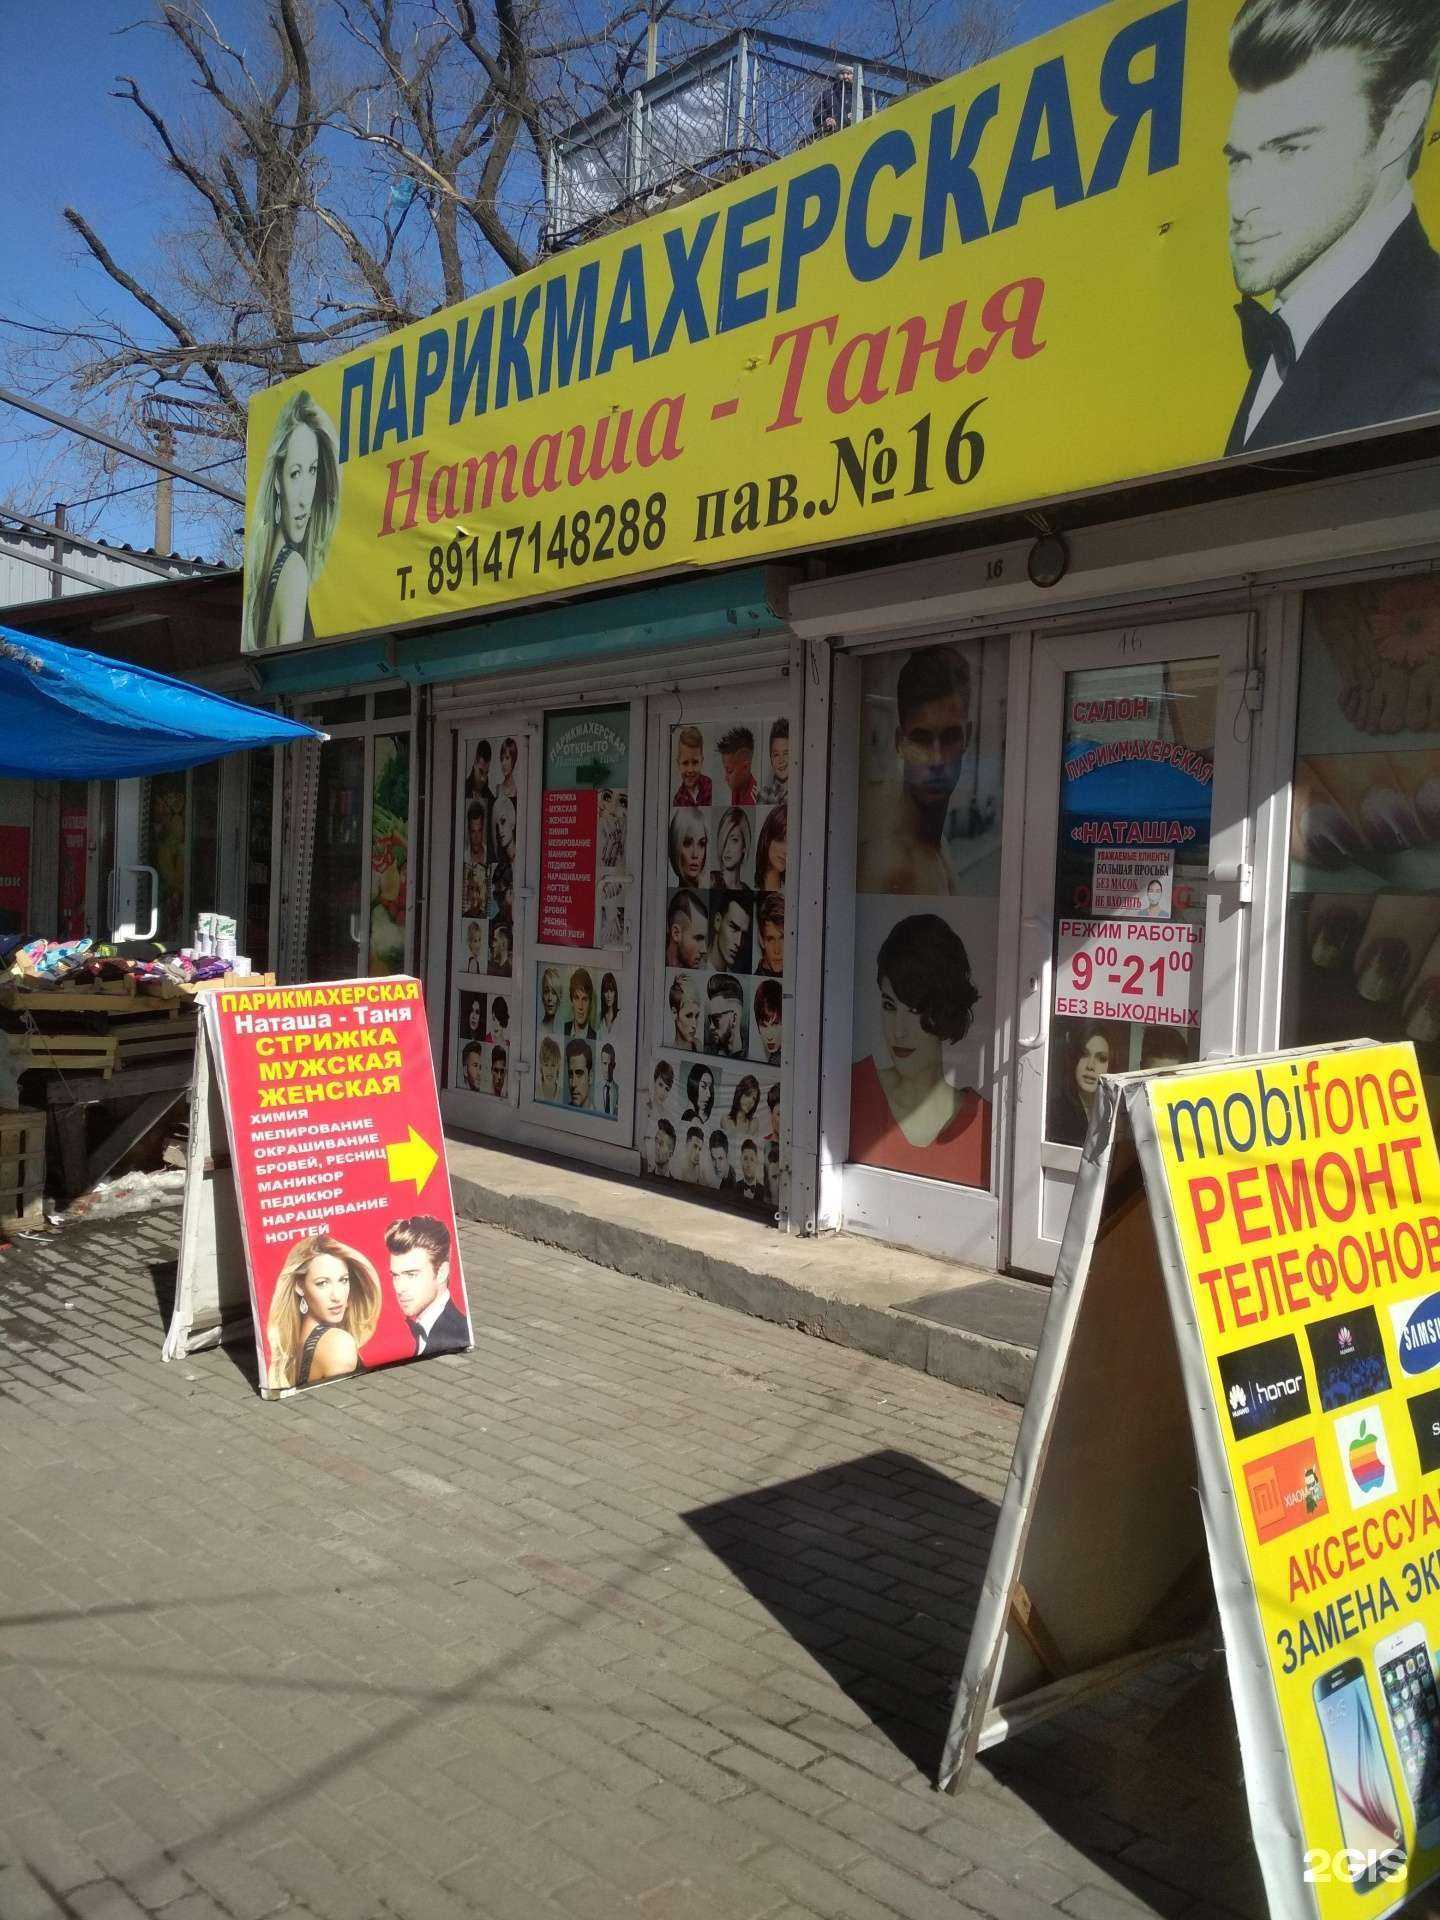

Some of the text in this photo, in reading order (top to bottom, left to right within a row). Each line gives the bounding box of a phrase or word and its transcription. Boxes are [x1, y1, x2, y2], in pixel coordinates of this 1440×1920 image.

[338, 0, 1189, 465] ПАРИКМАХЕРСКАЯ
[377, 393, 686, 538] Наташа
[765, 277, 1047, 433] Таня
[427, 492, 667, 596] 89147148288
[986, 558, 1004, 581] 16
[1072, 697, 1149, 722] САЛОН
[1065, 739, 1214, 785] ПАРИКМАХЕРСКАЯ
[1096, 863, 1169, 876] БОЛЬШАЯ ПРОСЬБА
[1096, 878, 1139, 890] БЕЗ МАСОК
[1095, 896, 1105, 908] НЕ
[1061, 922, 1203, 944] РЕЖИМ РАБОТЫ
[221, 983, 419, 1013] ПАРИКМАХЕРСКАЯ
[1057, 997, 1199, 1026] БЕЗ ВЫХОДНЫХ
[234, 1011, 332, 1035] Наташа
[353, 1004, 412, 1026] Таня
[255, 1027, 397, 1057] СТРИЖКА
[259, 1050, 402, 1082] МУЖСКАЯ
[259, 1075, 401, 1108] ЖЕНСКАЯ
[250, 1109, 309, 1125] ХИМИЯ
[1167, 1061, 1419, 1163] mobifone
[251, 1118, 374, 1143] МЕЛИРОВАНИЕ
[254, 1133, 379, 1159] ОКРАШИВАНИЕ
[256, 1147, 387, 1176] БРОВЕЙ, РЕСНИЦ
[258, 1171, 344, 1192] МАНИКЮР
[1188, 1136, 1422, 1254] РЕМОНТ
[260, 1188, 344, 1211] ПЕДИКЮР
[262, 1198, 389, 1227] НАРАЩИВАНИЕ
[265, 1223, 330, 1244] НОГТЕЙ
[1198, 1216, 1440, 1334] ТЕЛЕФОНОВ
[1255, 1376, 1303, 1404] honor
[1289, 1488, 1440, 1602] АКСЕССУА
[1277, 1549, 1440, 1674] ЗАМЕНА ЭК
